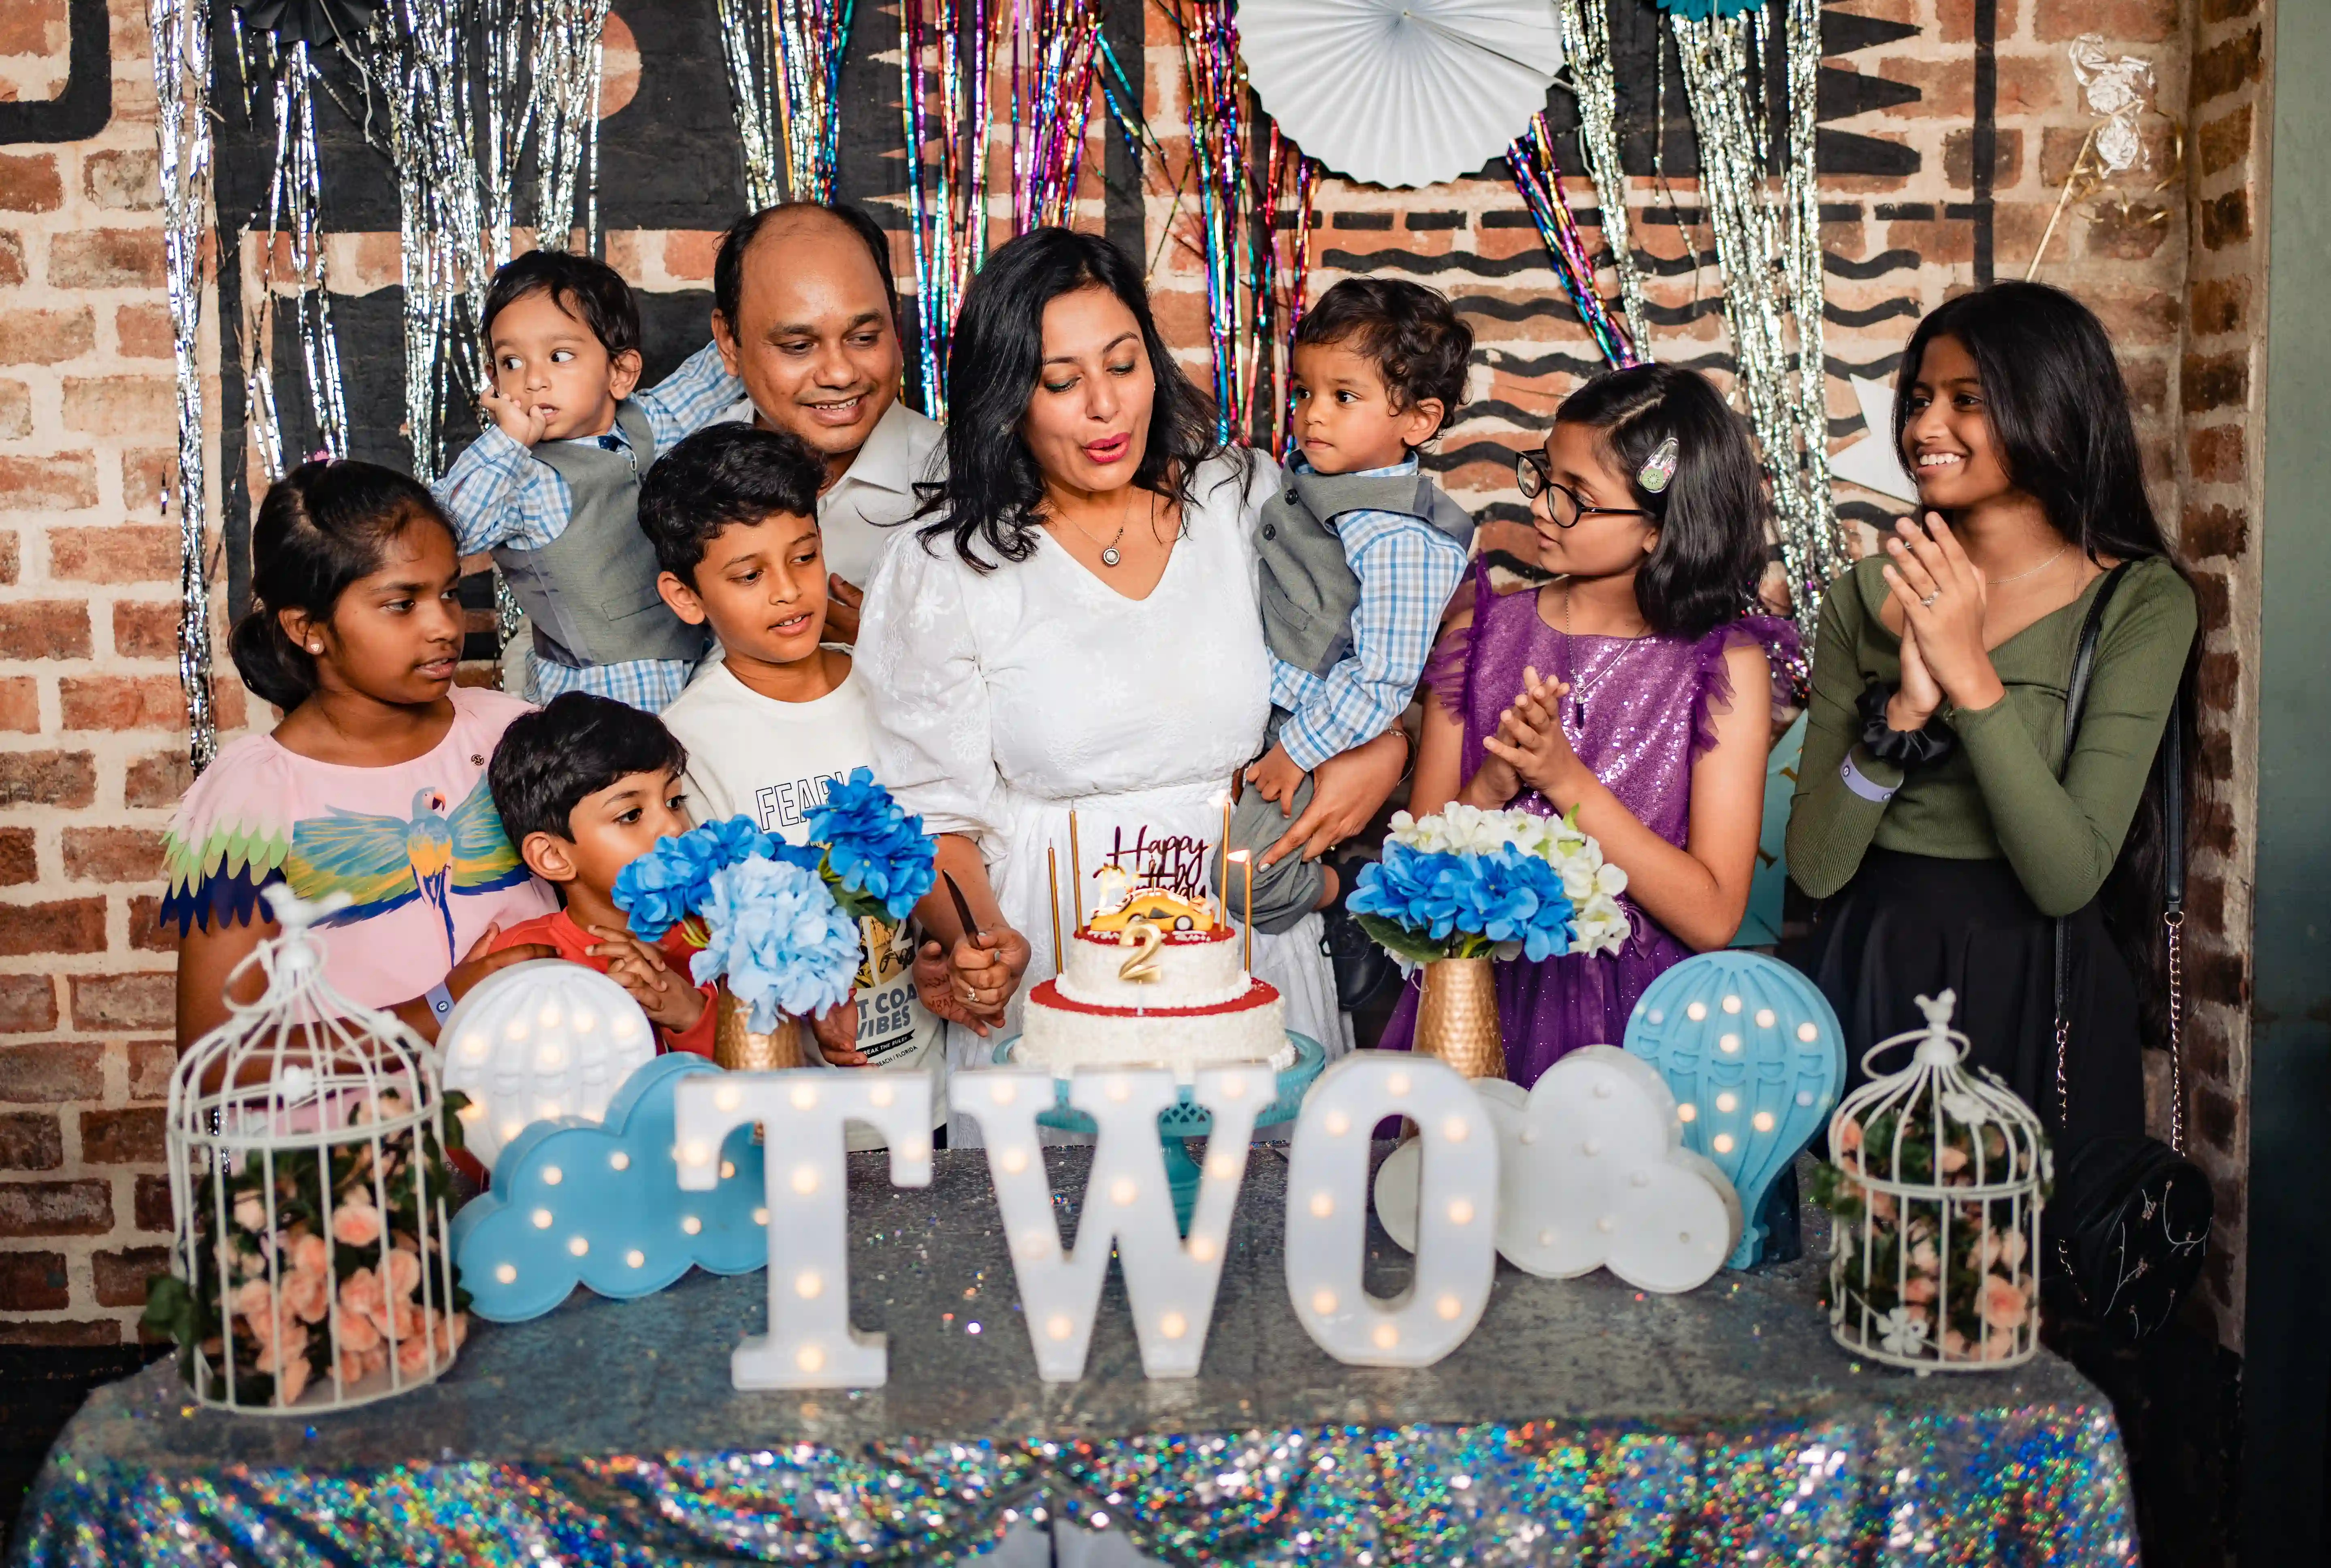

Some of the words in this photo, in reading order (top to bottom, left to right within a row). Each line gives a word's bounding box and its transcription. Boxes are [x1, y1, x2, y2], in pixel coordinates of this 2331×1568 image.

[756, 765, 868, 831] FEAR
[1106, 824, 1214, 887] Happy
[1119, 921, 1161, 982] 2
[857, 1006, 910, 1041] VIBES
[892, 1036, 908, 1046] RULES
[896, 1046, 918, 1058] FLORIDA
[675, 1052, 1498, 1391] TWO
